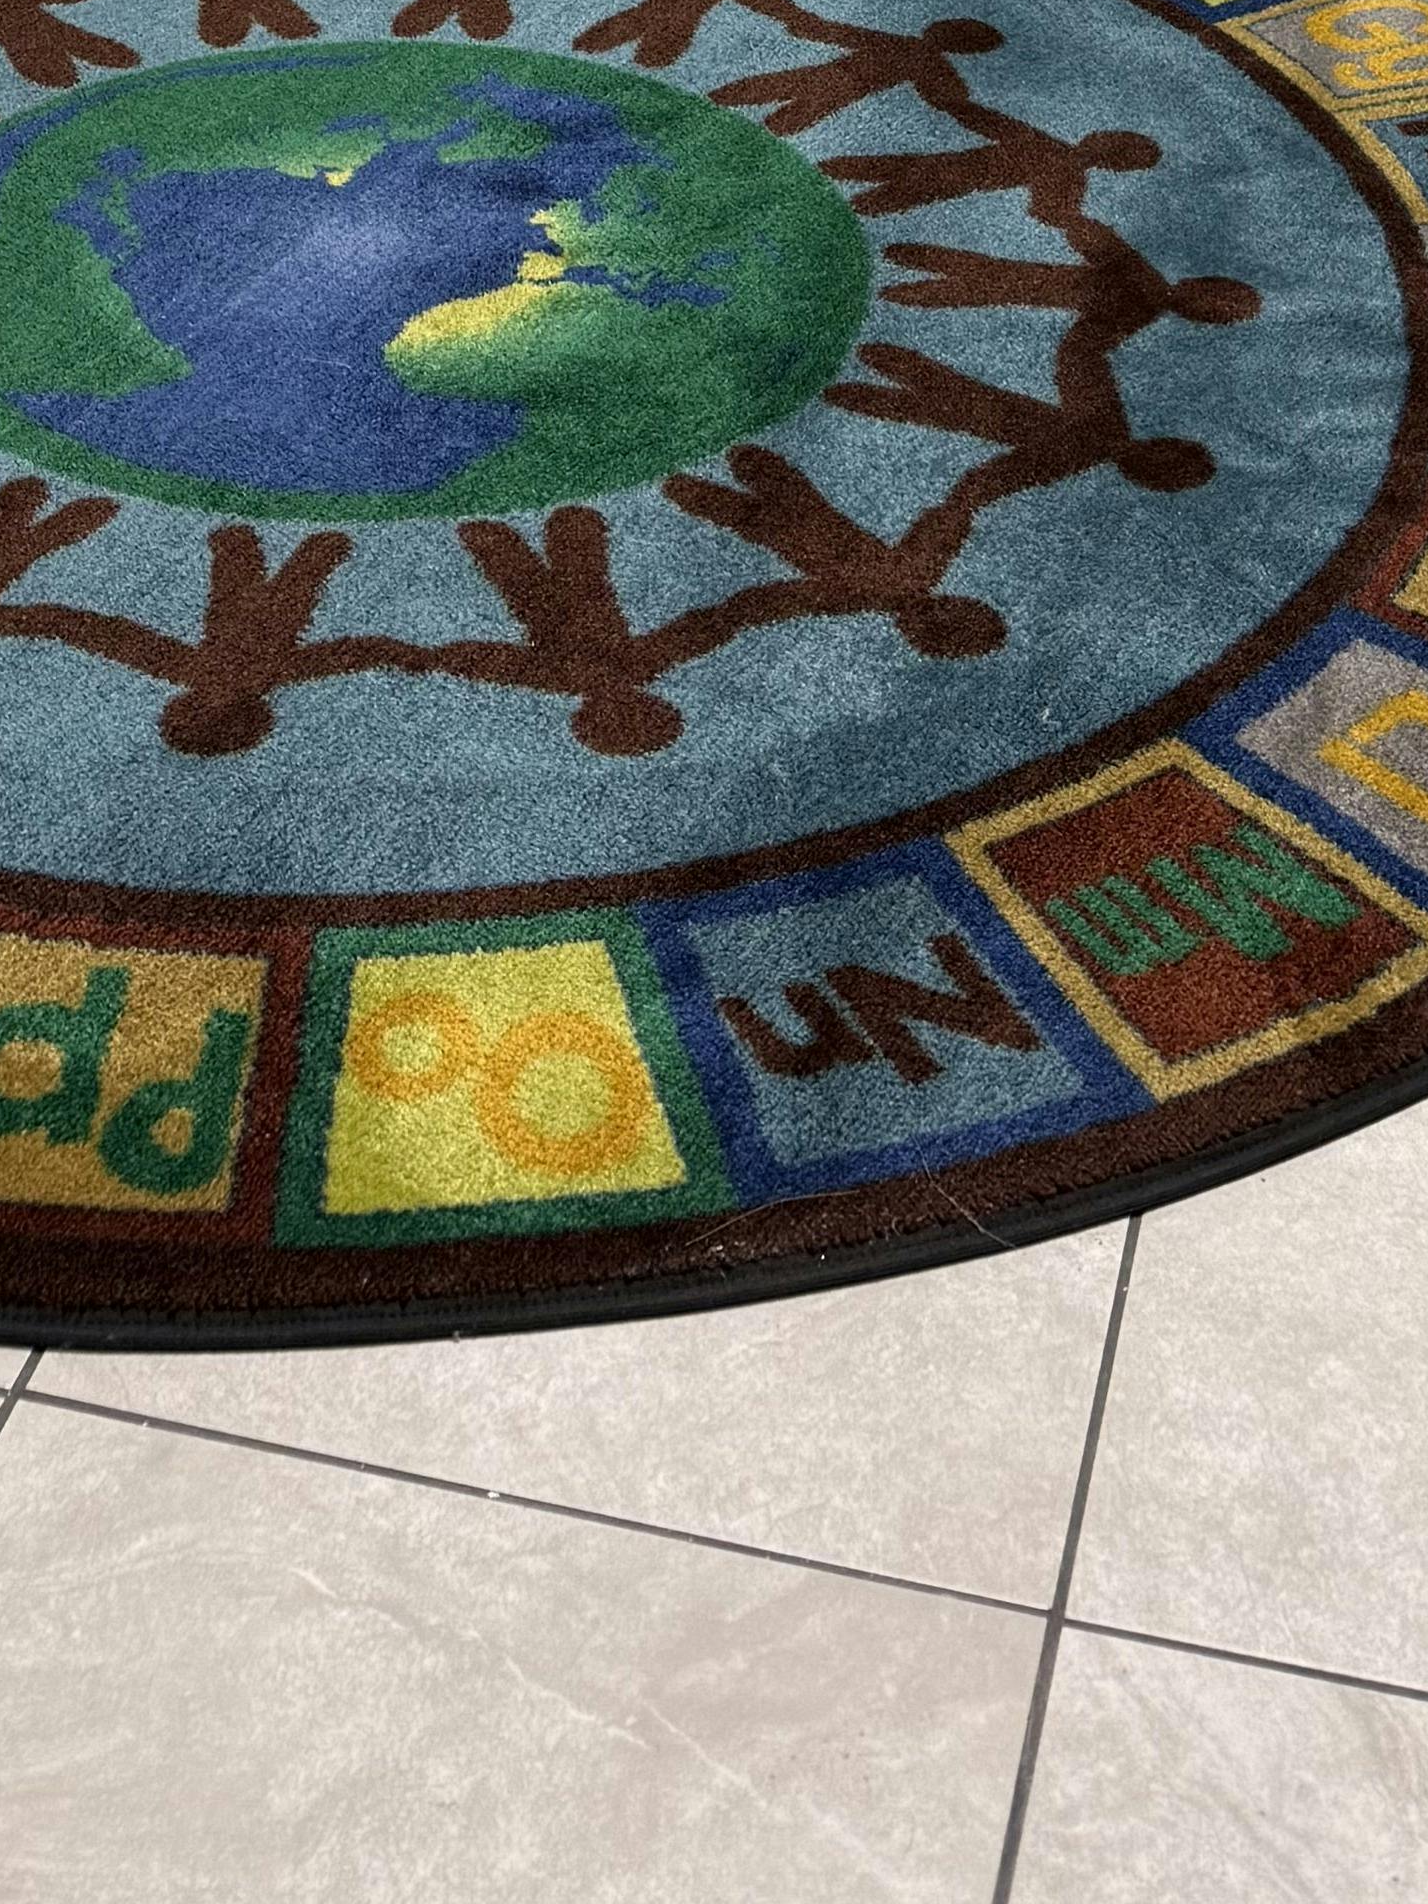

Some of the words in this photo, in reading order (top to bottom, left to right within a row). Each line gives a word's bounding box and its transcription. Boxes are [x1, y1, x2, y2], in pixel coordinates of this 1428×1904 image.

[1045, 825, 1367, 976] Mm
[349, 988, 649, 1177] Oo
[715, 933, 1041, 1085] Nn
